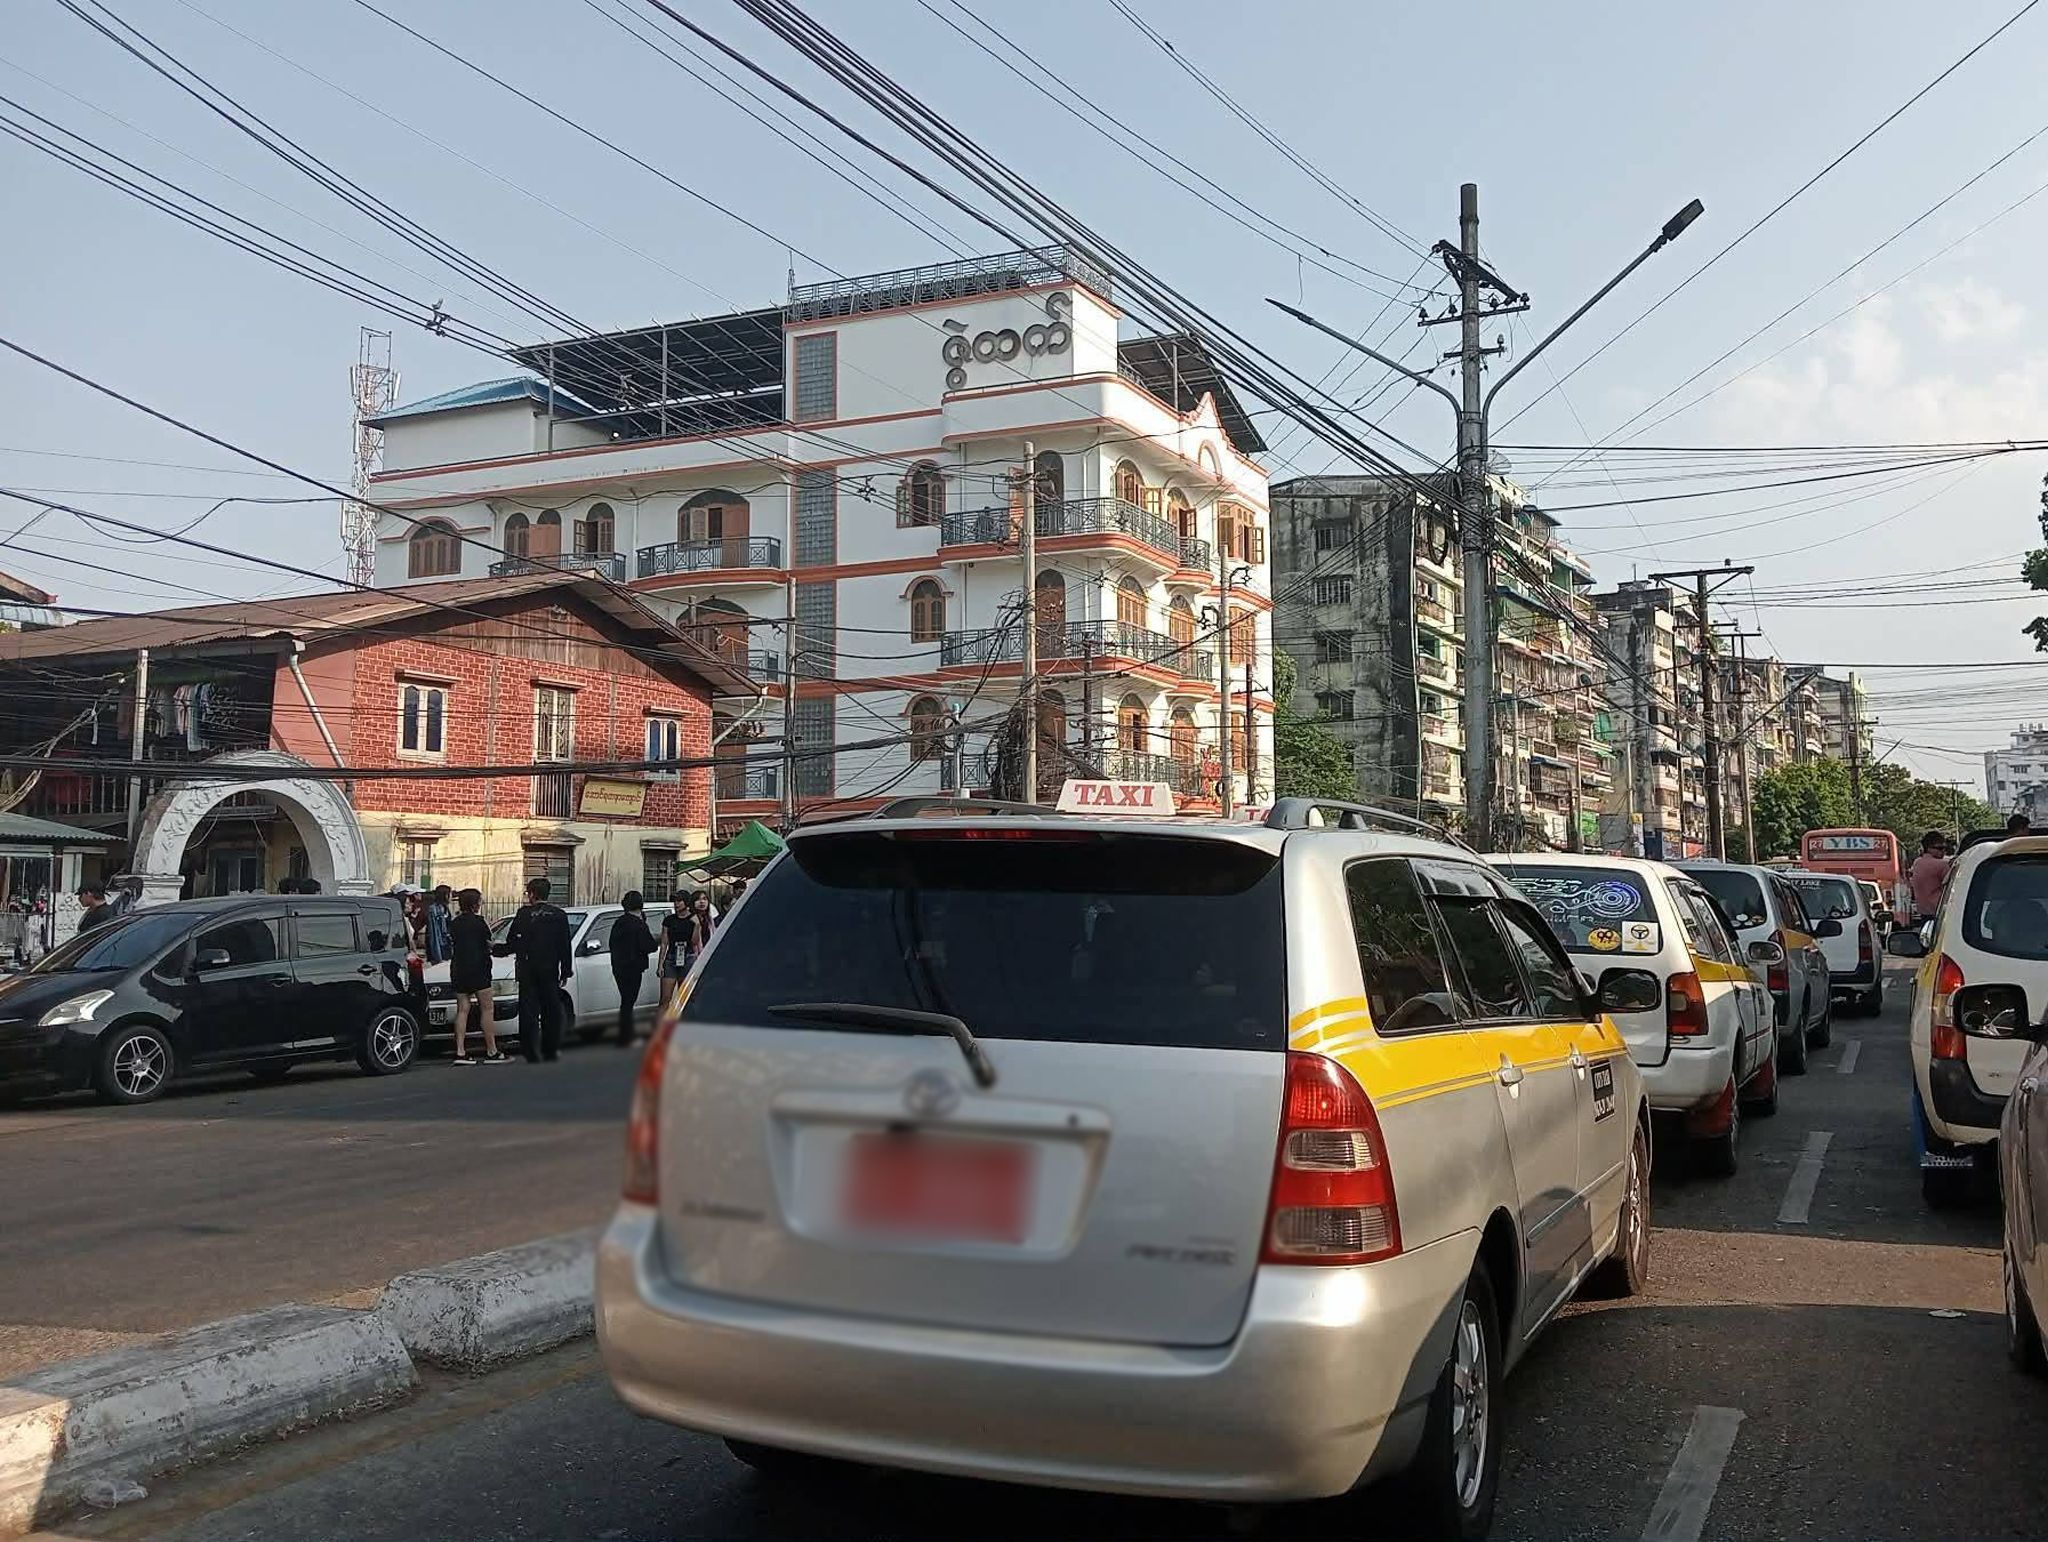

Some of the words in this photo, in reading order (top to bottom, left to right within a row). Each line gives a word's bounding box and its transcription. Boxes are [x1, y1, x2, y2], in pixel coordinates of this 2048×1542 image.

[1074, 783, 1155, 808] TAXI
[1811, 839, 1823, 848] 27
[1830, 838, 1870, 848] YBS
[1873, 839, 1887, 849] 27
